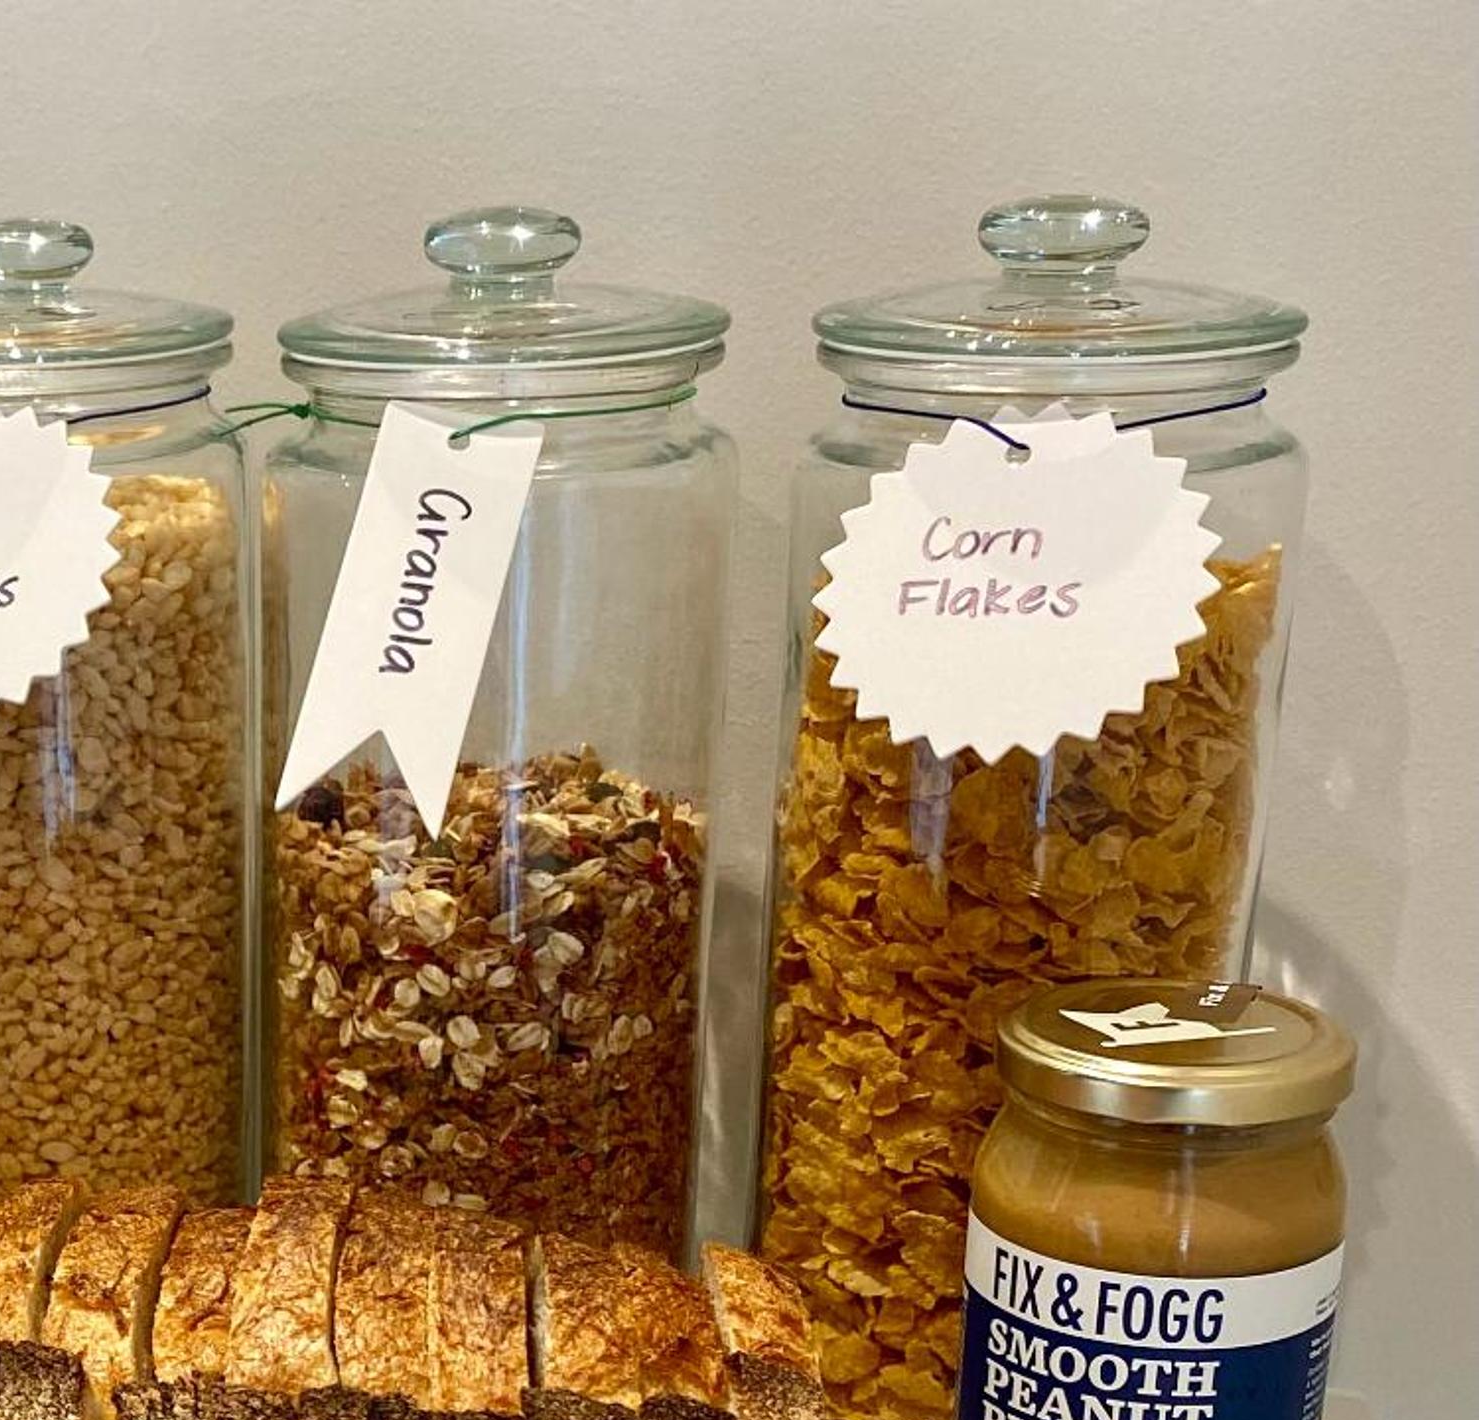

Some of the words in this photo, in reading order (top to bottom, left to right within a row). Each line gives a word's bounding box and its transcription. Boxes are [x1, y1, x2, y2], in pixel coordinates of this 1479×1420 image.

[921, 516, 1044, 562] Corn
[378, 487, 472, 675] Granola
[898, 579, 1082, 618] Flakes
[993, 1246, 1044, 1321] FIX
[1050, 1272, 1084, 1332] &
[1095, 1280, 1225, 1344] FOGG
[986, 1318, 1220, 1398] SMOOTH
